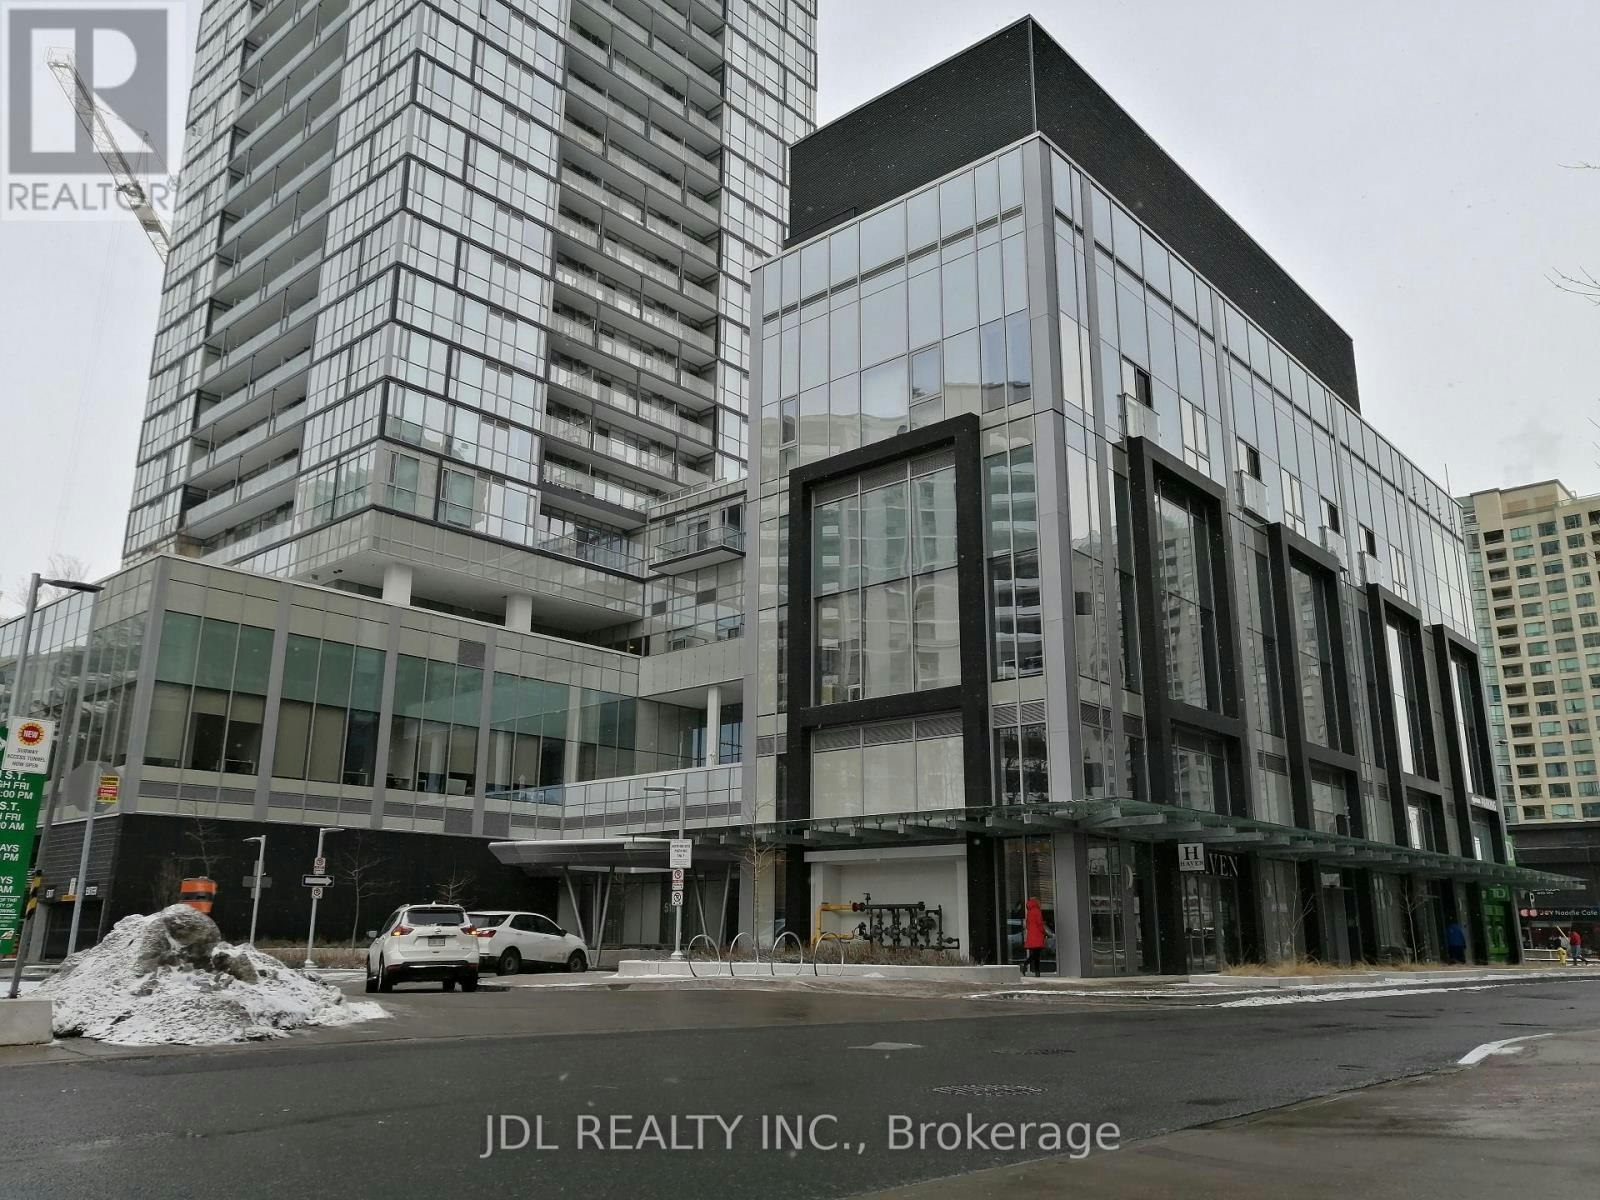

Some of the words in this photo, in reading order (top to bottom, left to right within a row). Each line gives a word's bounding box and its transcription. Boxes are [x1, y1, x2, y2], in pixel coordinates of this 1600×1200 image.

[23, 730, 39, 738] NEW
[13, 781, 30, 790] FRI
[17, 791, 33, 800] PM
[5, 812, 21, 821] FRI
[8, 822, 25, 831] AM
[3, 853, 19, 862] PM
[1184, 846, 1200, 860] H
